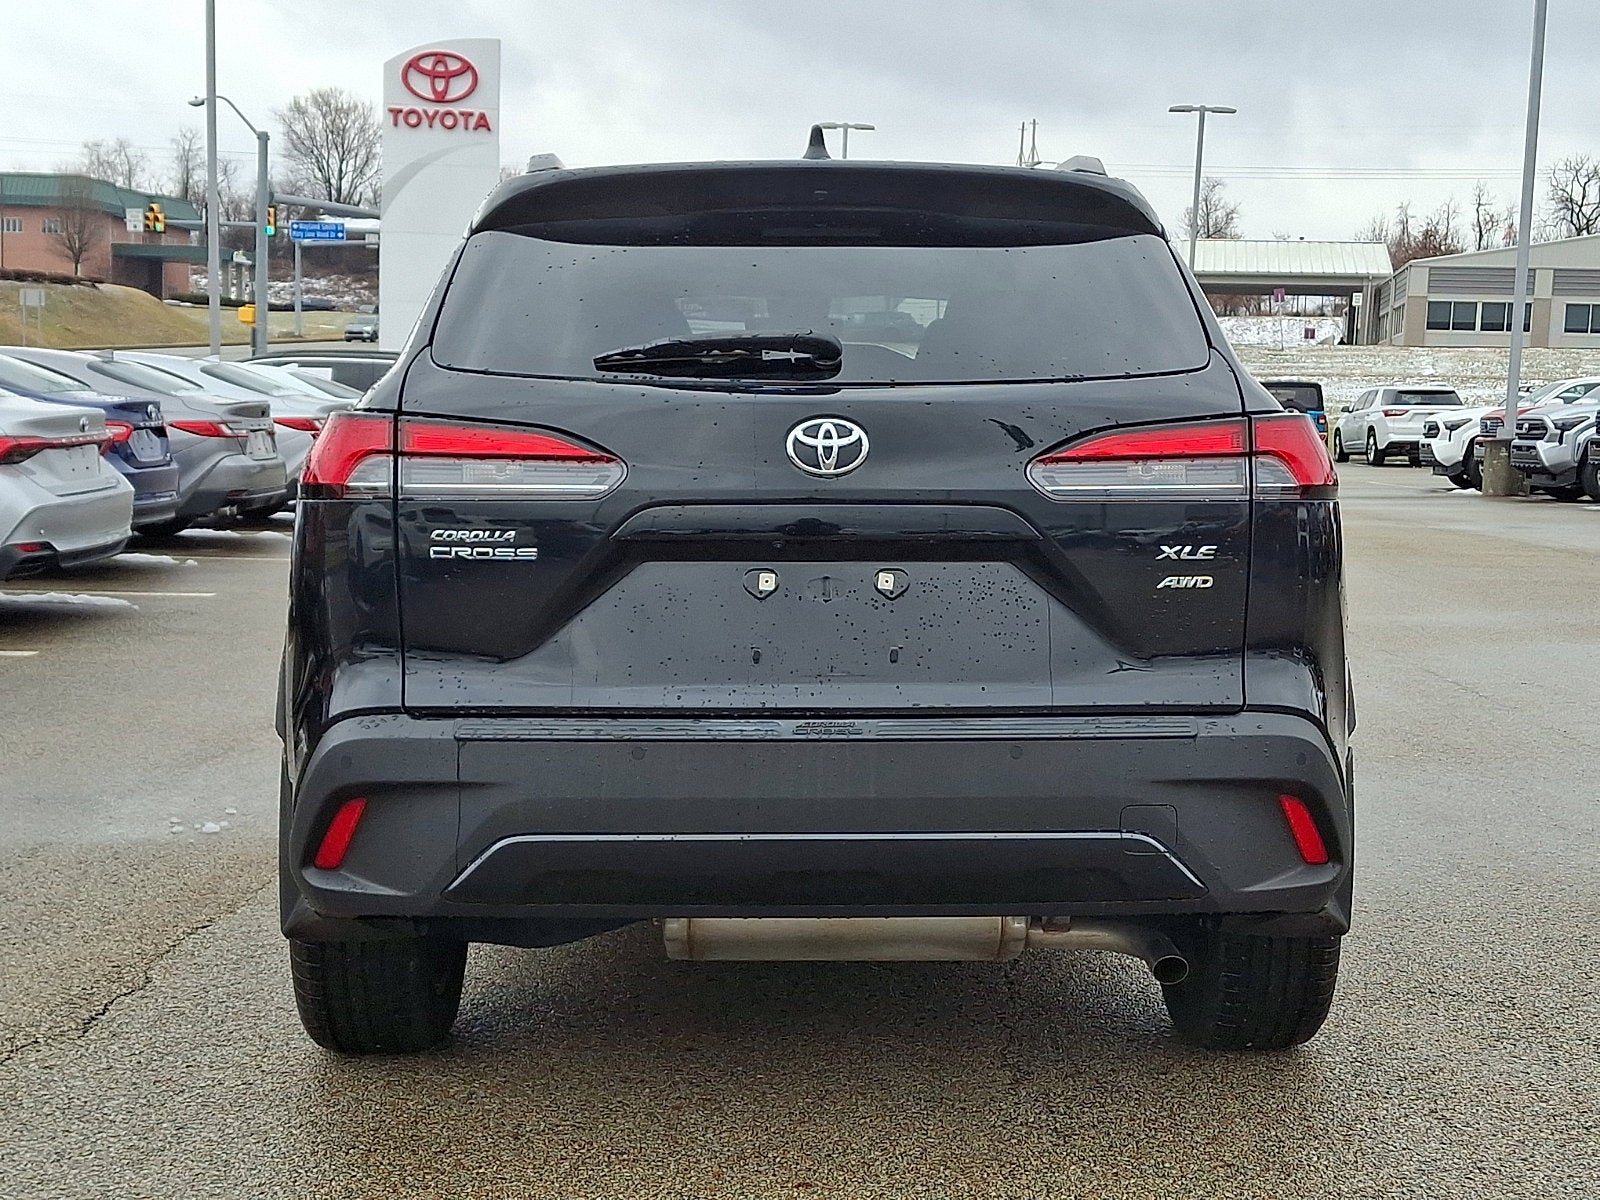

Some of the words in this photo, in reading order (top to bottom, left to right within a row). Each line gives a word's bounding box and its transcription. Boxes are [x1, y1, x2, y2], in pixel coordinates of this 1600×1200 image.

[388, 107, 491, 131] TOYOTA
[430, 529, 517, 543] COROLLA
[429, 546, 538, 560] CROSS
[1155, 545, 1218, 560] XLE
[1156, 575, 1214, 589] AWD
[791, 728, 864, 736] CROSS
